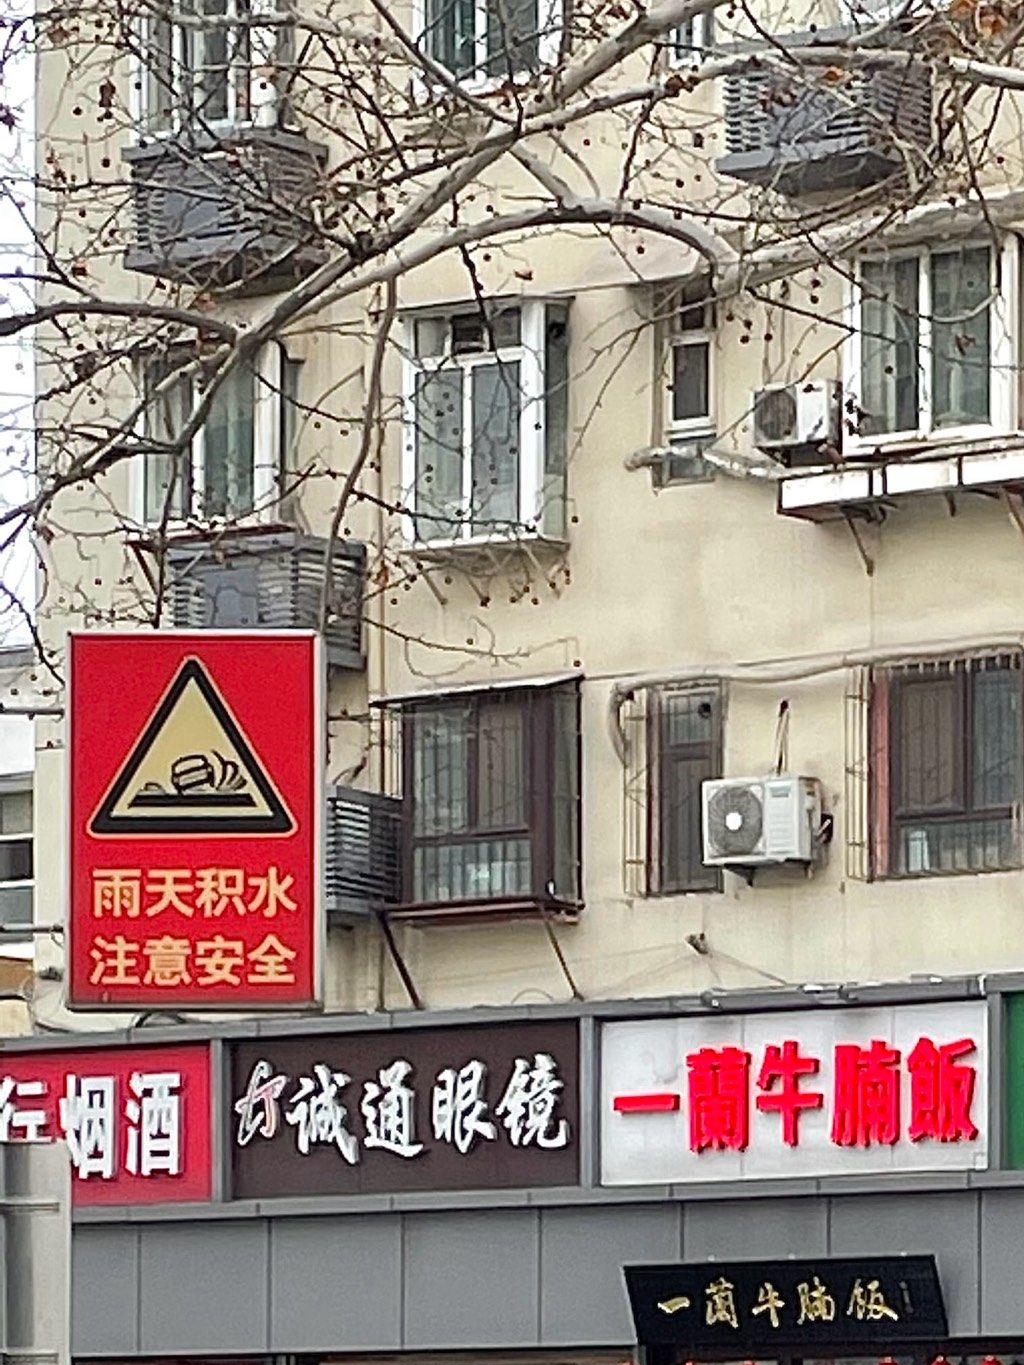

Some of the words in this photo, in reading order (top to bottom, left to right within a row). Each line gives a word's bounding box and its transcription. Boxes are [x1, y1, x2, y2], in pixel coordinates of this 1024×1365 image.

[92, 866, 297, 918] 雨天积水
[90, 934, 296, 985] 注意安全
